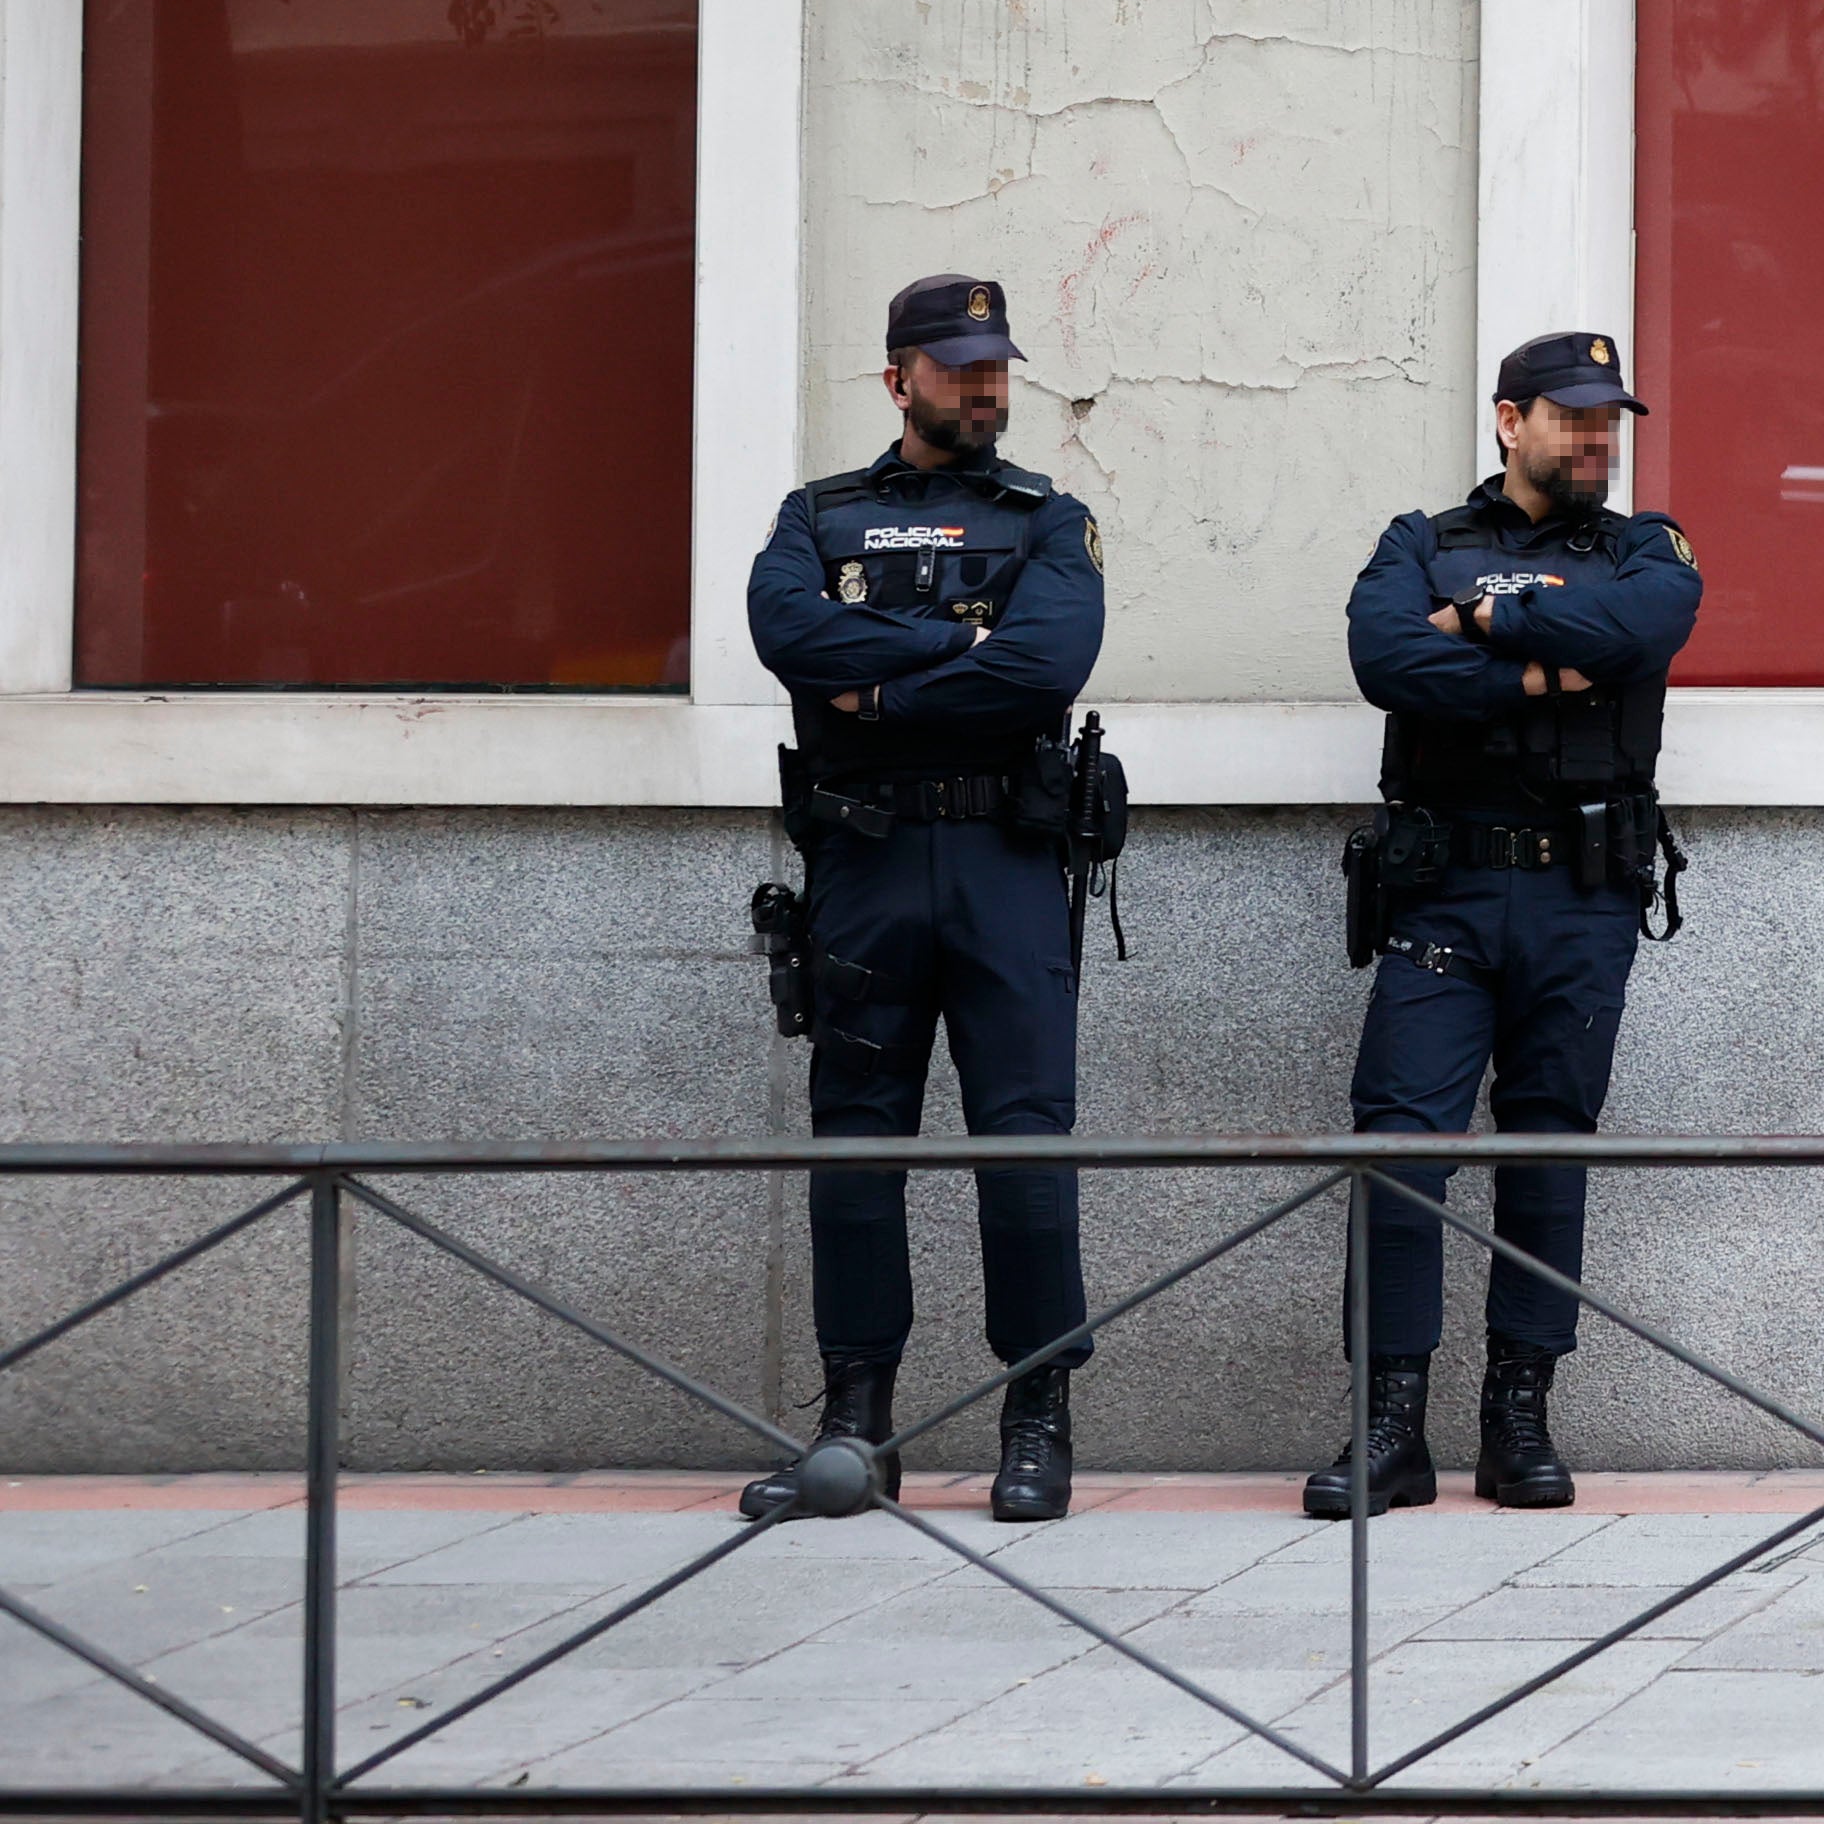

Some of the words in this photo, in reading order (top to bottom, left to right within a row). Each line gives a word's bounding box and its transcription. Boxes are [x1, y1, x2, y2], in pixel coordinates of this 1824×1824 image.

[864, 526, 945, 539] POLICIA
[864, 537, 964, 550] NACIONAL
[1475, 572, 1546, 587] POLICIA
